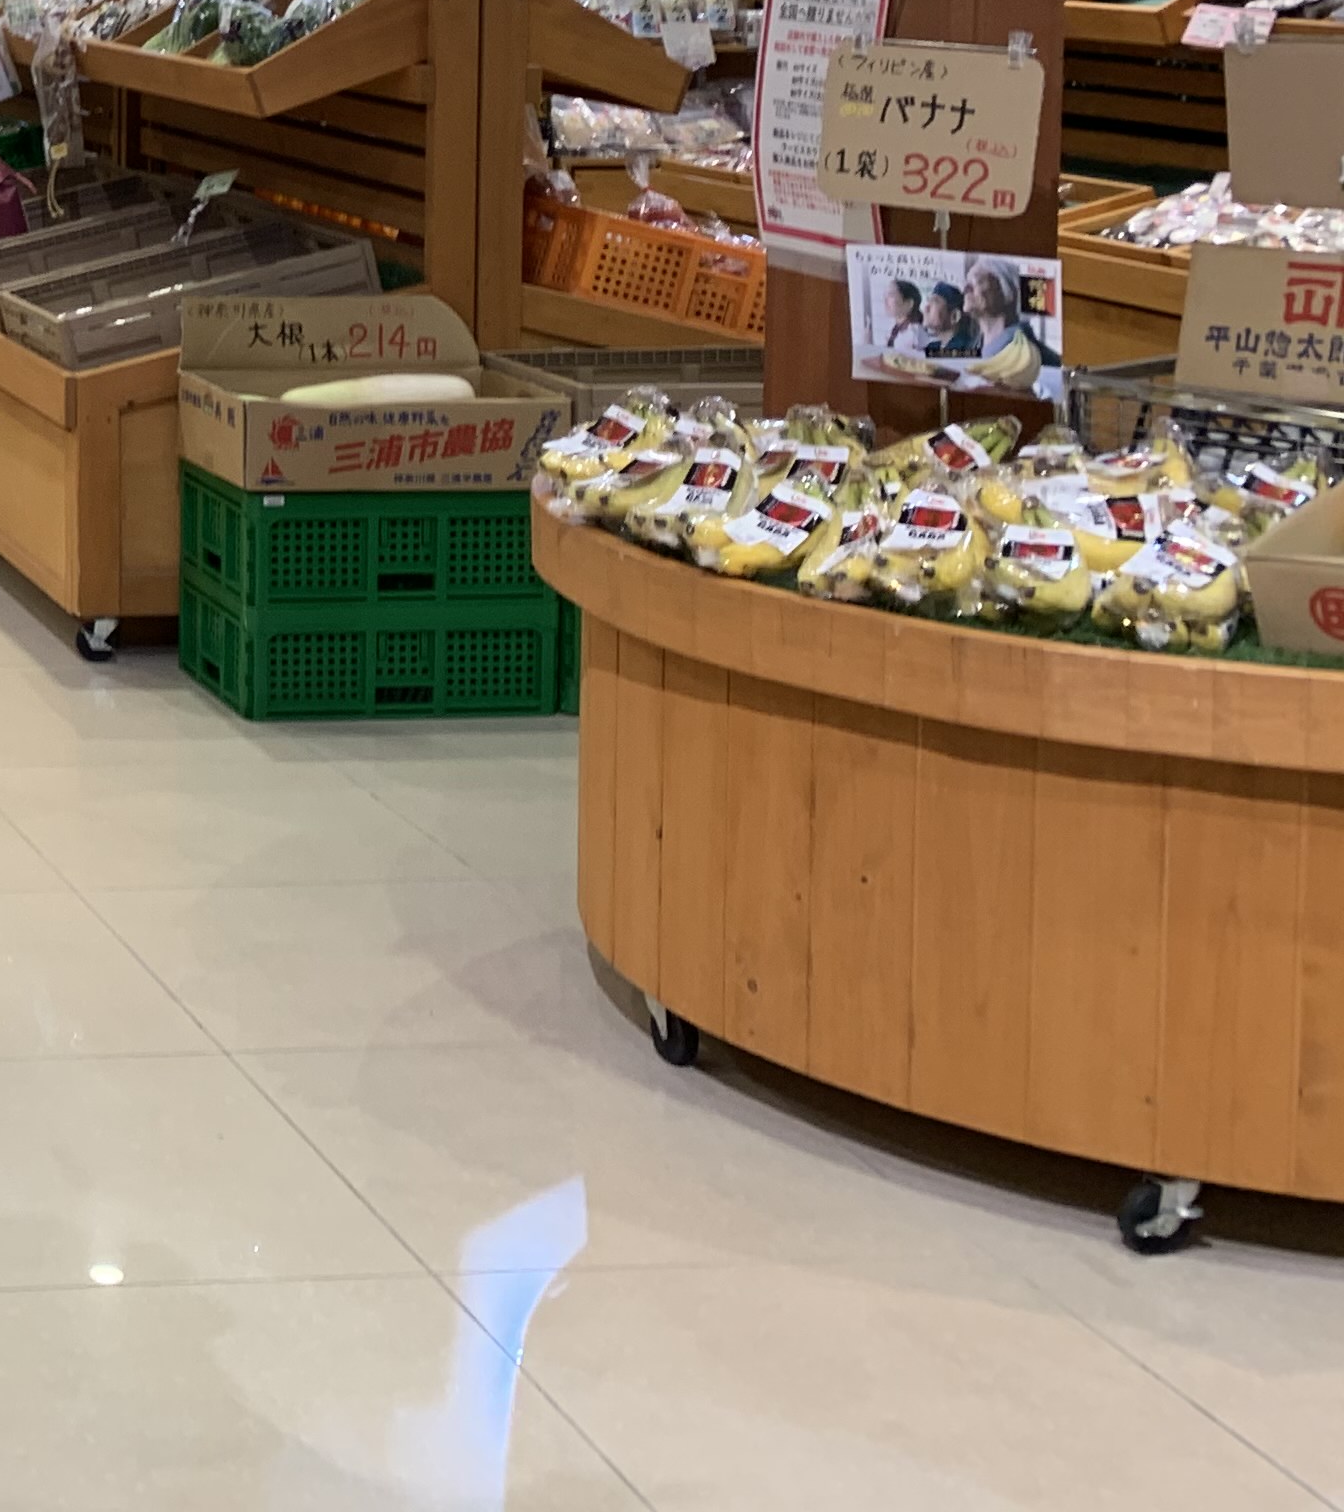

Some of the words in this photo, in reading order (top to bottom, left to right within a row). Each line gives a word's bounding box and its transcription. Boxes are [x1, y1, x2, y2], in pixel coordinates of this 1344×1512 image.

[880, 93, 976, 136] バナナ
[902, 152, 1016, 212] 322円
[248, 321, 304, 349] 大根
[347, 322, 438, 361] 214円
[327, 417, 517, 475] 三浦市農協
